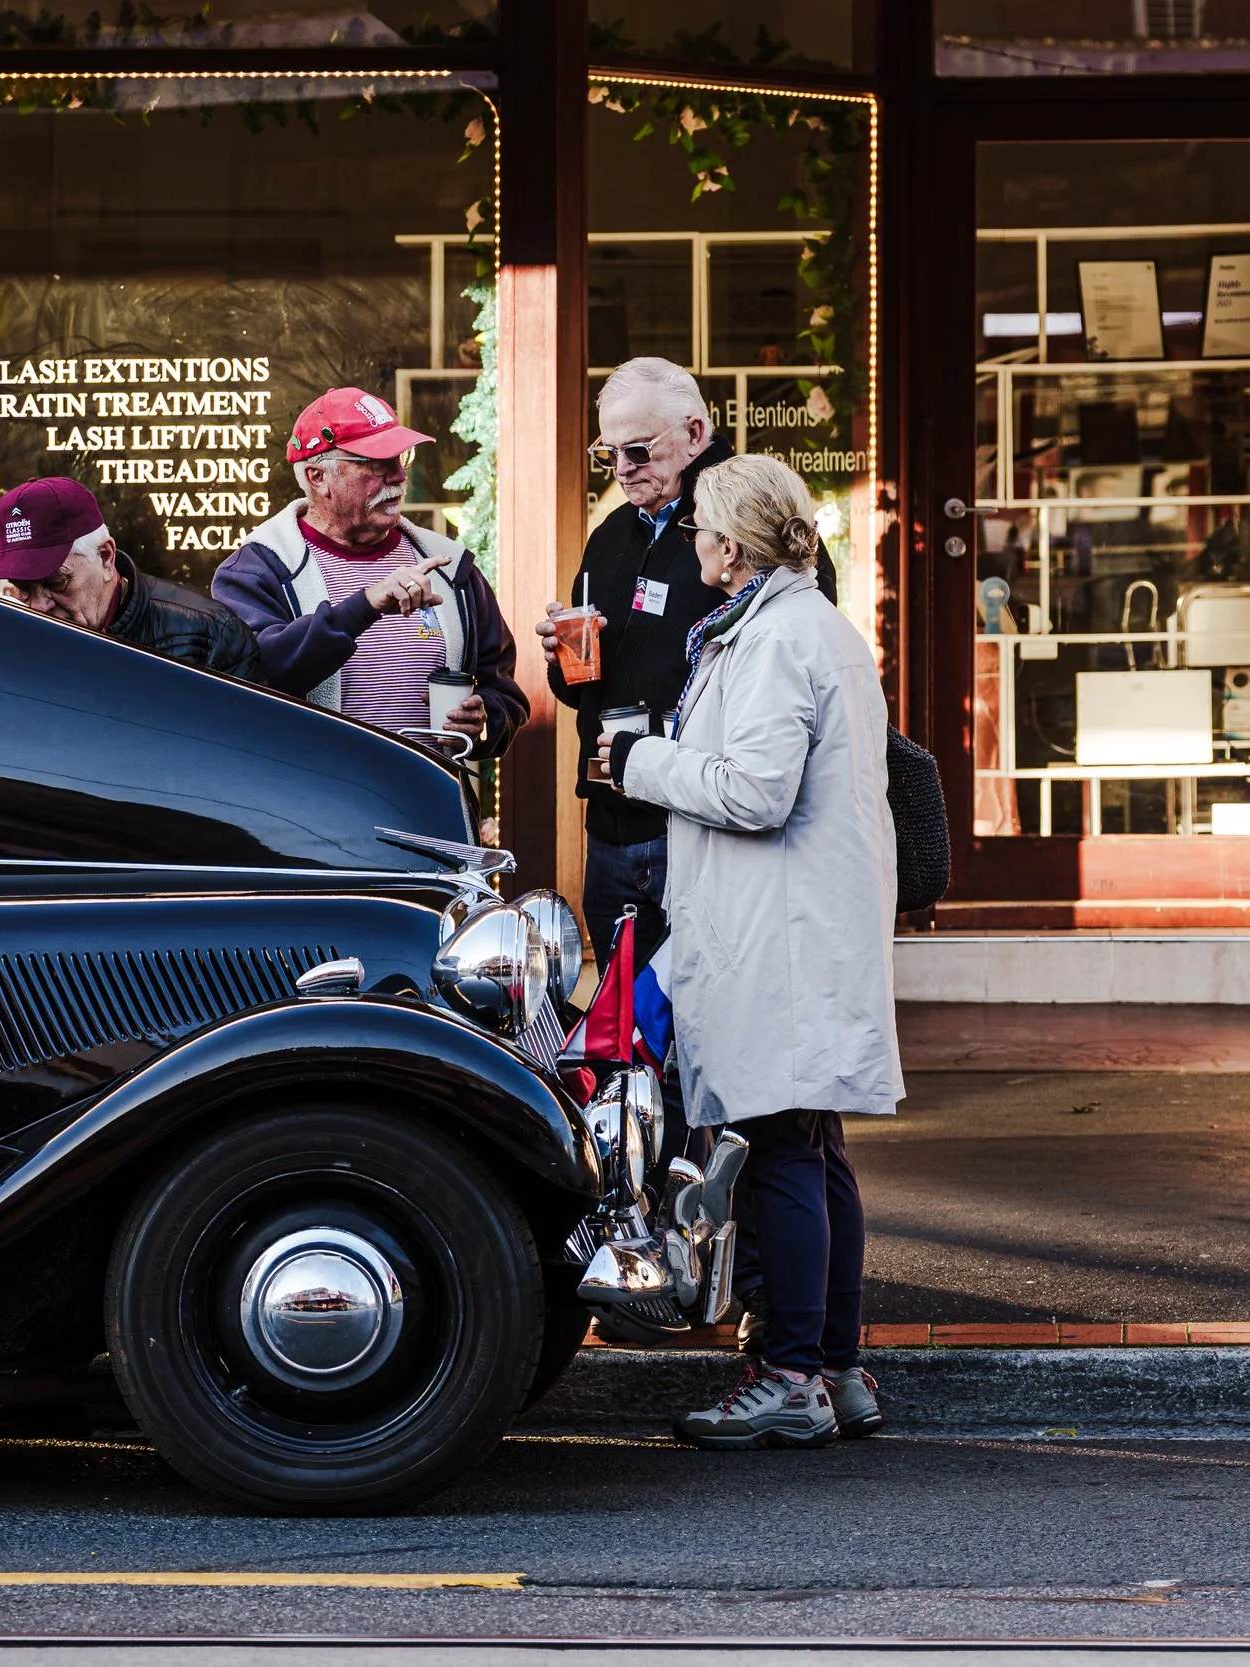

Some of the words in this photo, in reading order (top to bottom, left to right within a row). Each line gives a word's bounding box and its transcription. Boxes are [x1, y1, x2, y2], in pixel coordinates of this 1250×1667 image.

[83, 356, 270, 384] EXTENTIONS
[92, 390, 272, 416] TREATMENT
[726, 400, 818, 428] Etentions
[46, 426, 126, 451] LASH
[131, 424, 272, 450] LIFT/TINT
[96, 458, 271, 484] THREADING
[149, 492, 271, 517] WAXING
[5, 525, 32, 535] CLASSIC
[165, 525, 260, 551] FACIA
